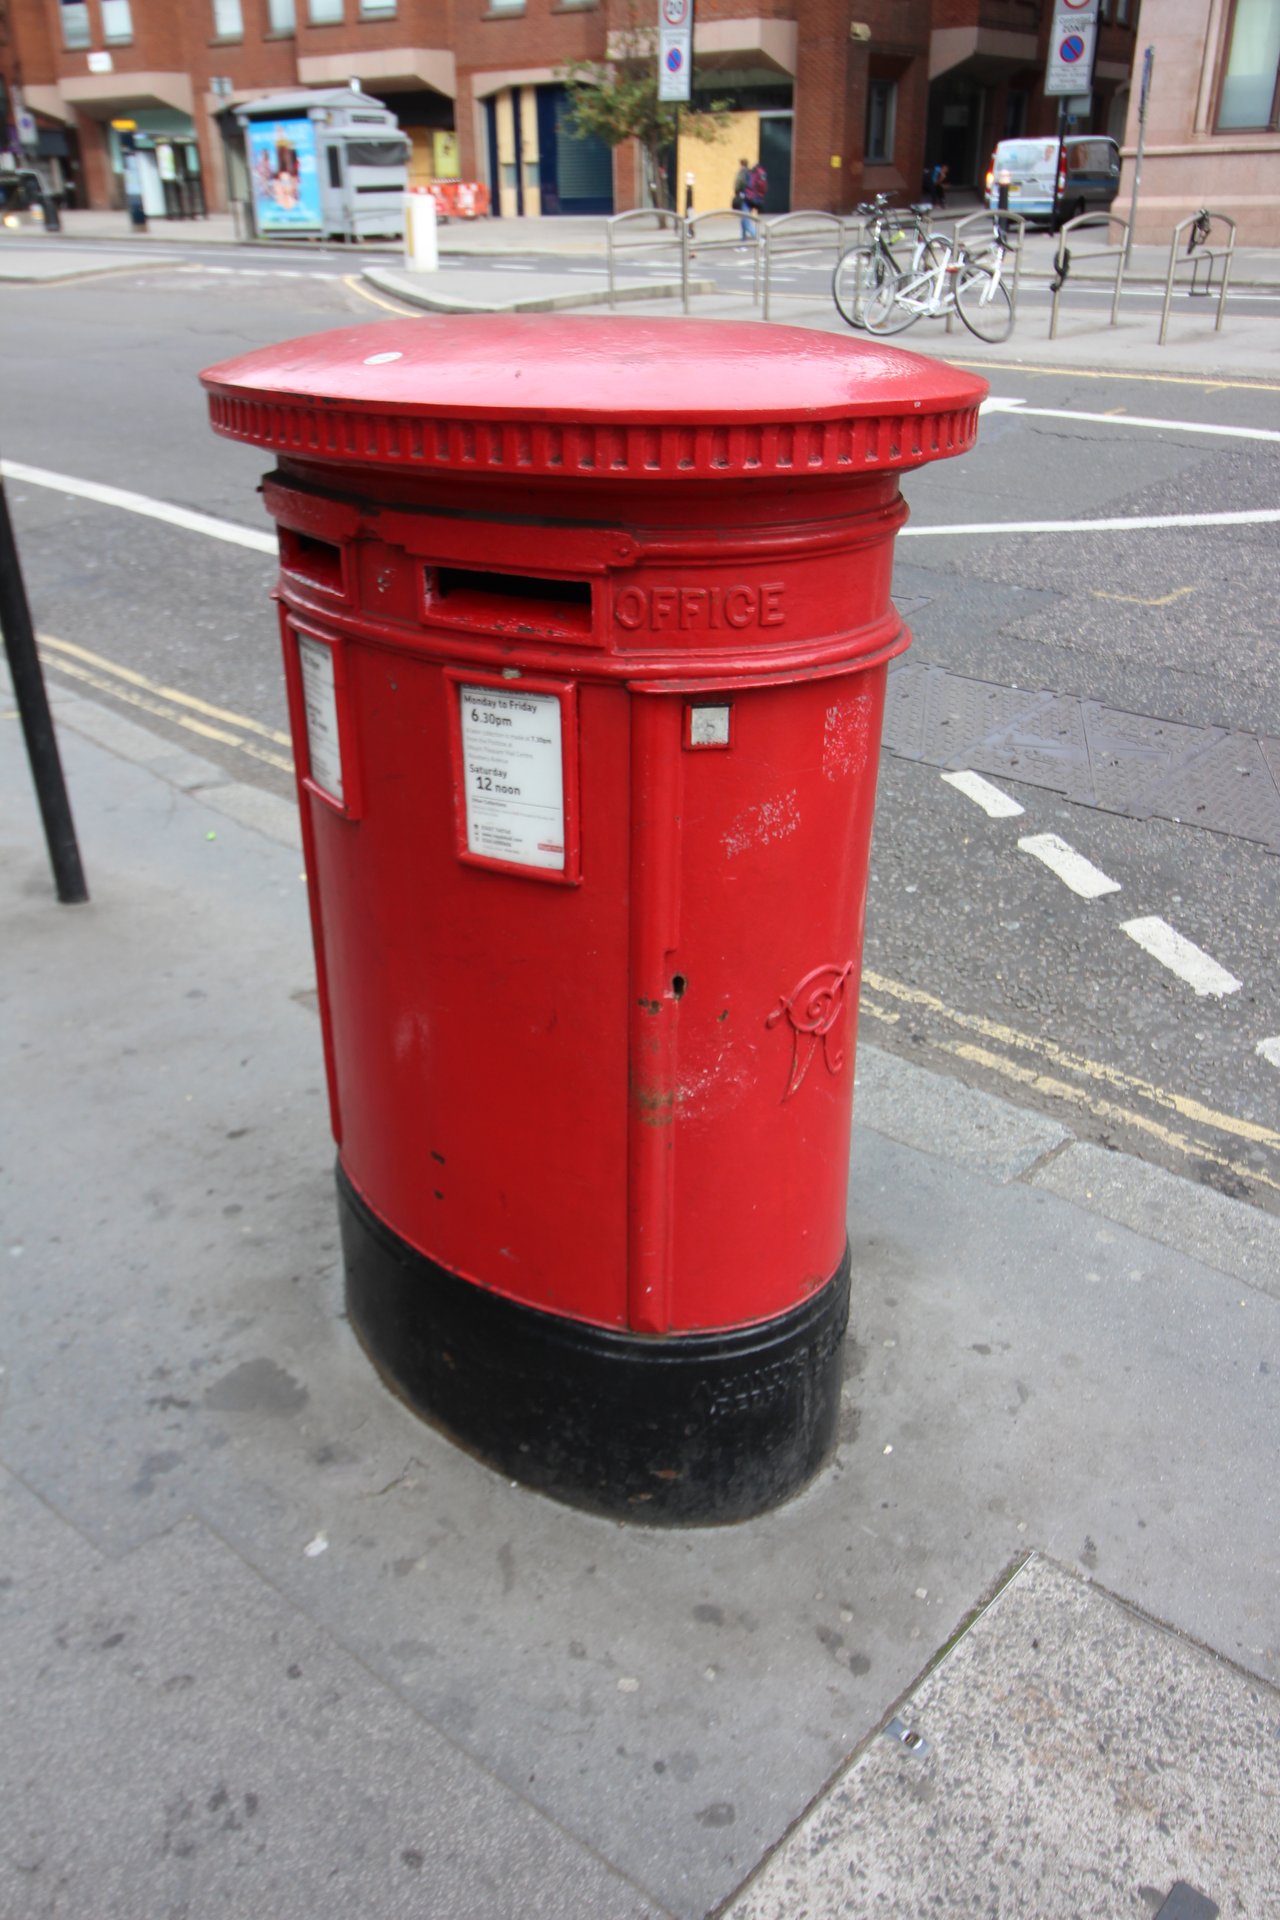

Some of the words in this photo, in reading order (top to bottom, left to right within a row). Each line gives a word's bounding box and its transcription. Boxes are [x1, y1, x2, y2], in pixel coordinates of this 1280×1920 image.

[616, 582, 785, 630] OFFICE
[463, 695, 496, 708] Monday
[498, 700, 508, 709] to
[509, 700, 537, 715] Friday
[471, 708, 513, 727] 6.30pm
[469, 763, 508, 780] Saturday
[476, 776, 493, 792] 12
[494, 784, 521, 796] noon
